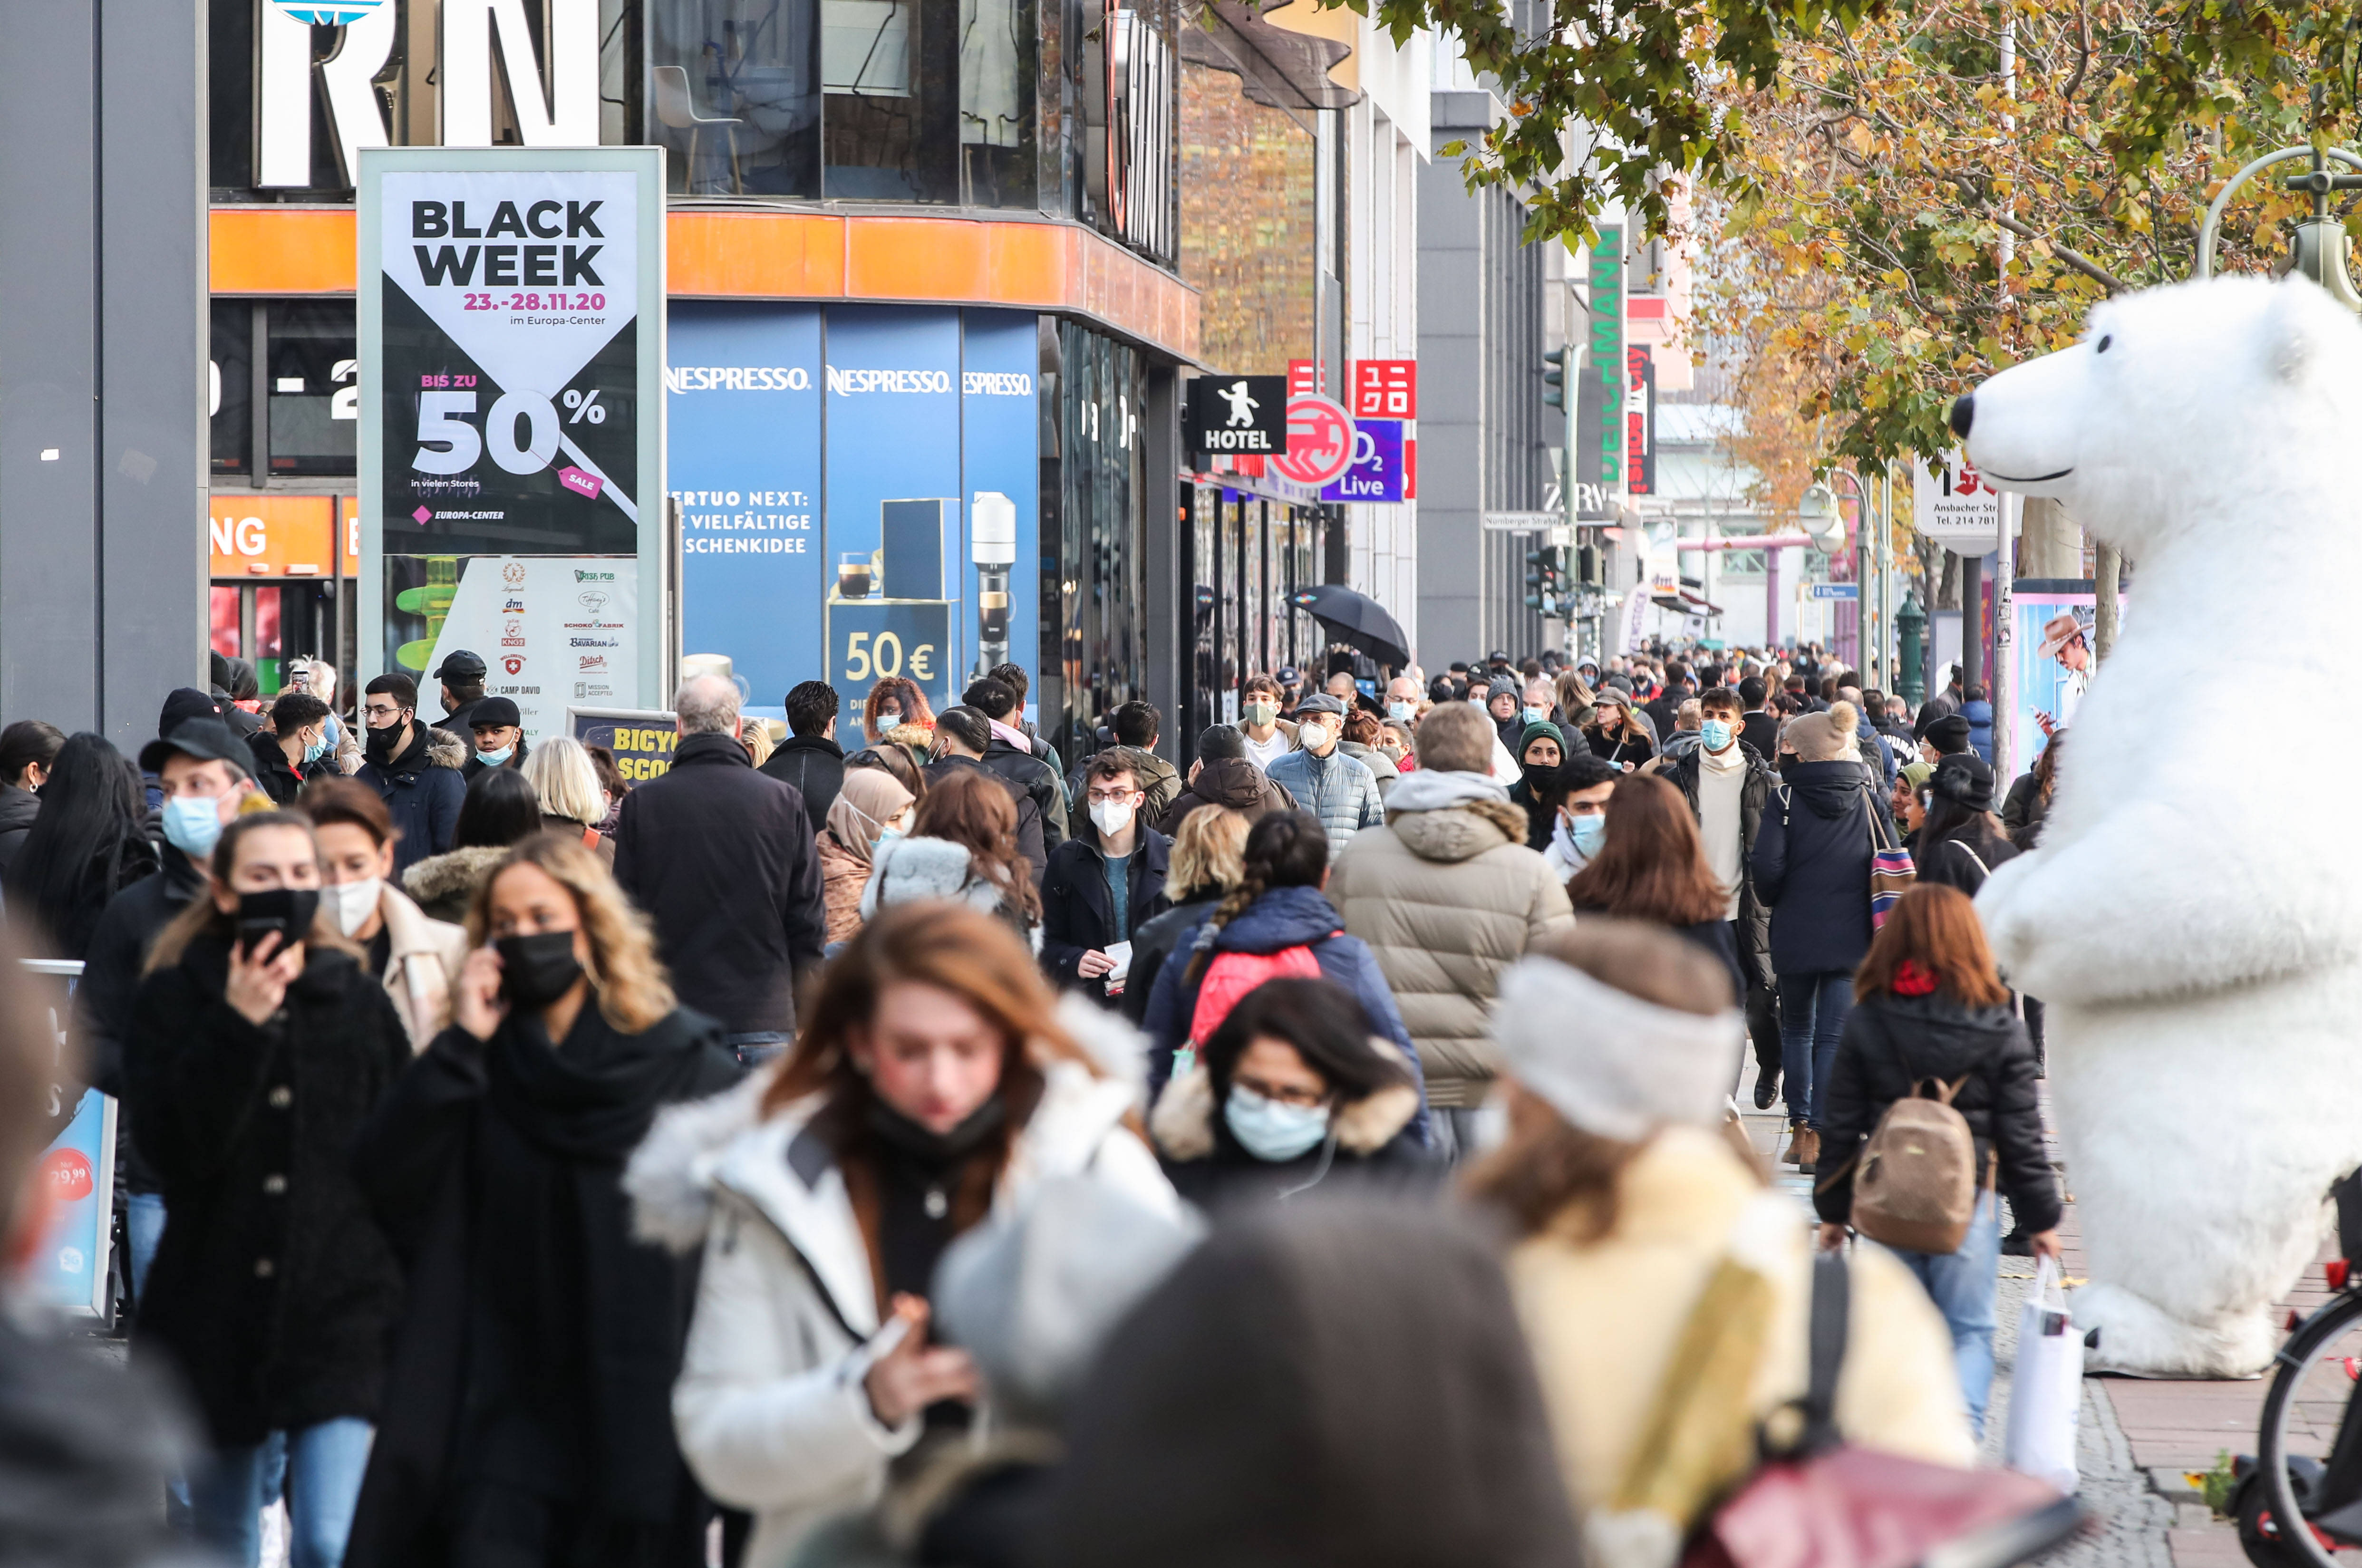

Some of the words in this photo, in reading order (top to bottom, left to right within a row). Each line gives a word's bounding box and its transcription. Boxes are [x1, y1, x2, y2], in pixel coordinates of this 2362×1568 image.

[412, 200, 605, 238] BLACK
[413, 245, 605, 286] WEEK
[464, 293, 606, 310] 23.-28.11.20
[511, 317, 524, 325] im
[527, 316, 605, 326] Europa-Center
[1593, 230, 1620, 482] DEICHMANN
[421, 375, 450, 387] BIS
[454, 375, 477, 387] ZU
[962, 372, 1032, 397] ESPRESSO
[1205, 430, 1272, 449] HOTEL
[422, 479, 448, 487] vielen
[451, 479, 479, 488] Stores
[568, 474, 595, 491] SALE
[1340, 475, 1384, 495] Live
[666, 491, 740, 506] ERTUO
[748, 491, 809, 506] NEXT:
[1544, 483, 1603, 513] ZRA
[435, 511, 504, 520] EUROPA-CENTER
[1934, 503, 1979, 513] Ansbacher
[690, 511, 811, 530] VIELFÄLTIGE
[1936, 516, 1952, 525] Tel.
[1955, 516, 1974, 525] 214
[1978, 516, 1994, 525] 781
[682, 538, 806, 553] SCHENKIDEE
[505, 598, 523, 609] dm
[570, 638, 607, 647] BAVARIAN
[579, 655, 603, 667] Ditsch
[846, 631, 902, 681] 50
[909, 644, 934, 680] €
[501, 686, 519, 694] CAMP
[521, 686, 541, 694] DAVID
[520, 707, 539, 716] öller
[849, 716, 865, 726] AN
[618, 757, 673, 781] SCO
[50, 1168, 86, 1185] 29,99
